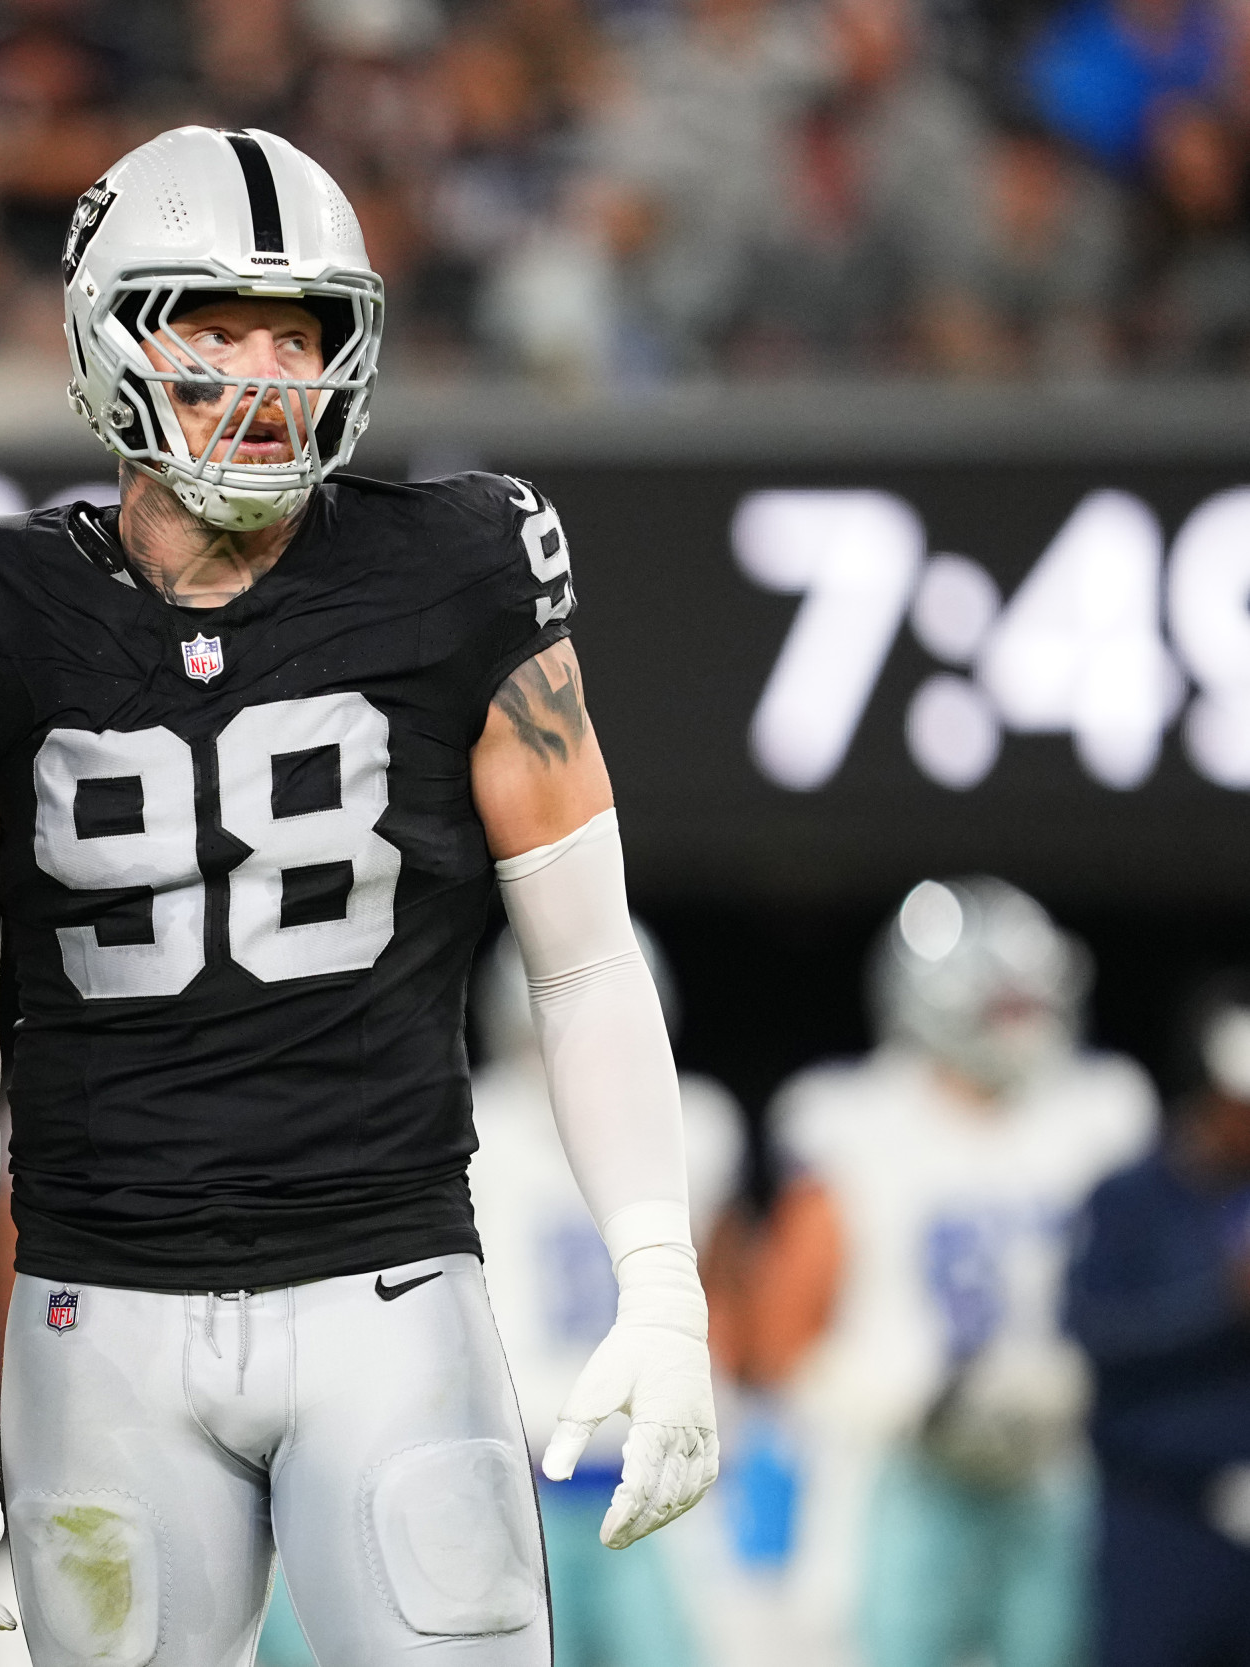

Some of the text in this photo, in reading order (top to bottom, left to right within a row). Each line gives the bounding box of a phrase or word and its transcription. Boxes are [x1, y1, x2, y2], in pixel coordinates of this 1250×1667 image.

[251, 257, 290, 266] RAIDERS
[190, 655, 218, 674] NFL
[33, 691, 402, 1000] 98
[50, 1307, 73, 1326] NFL
